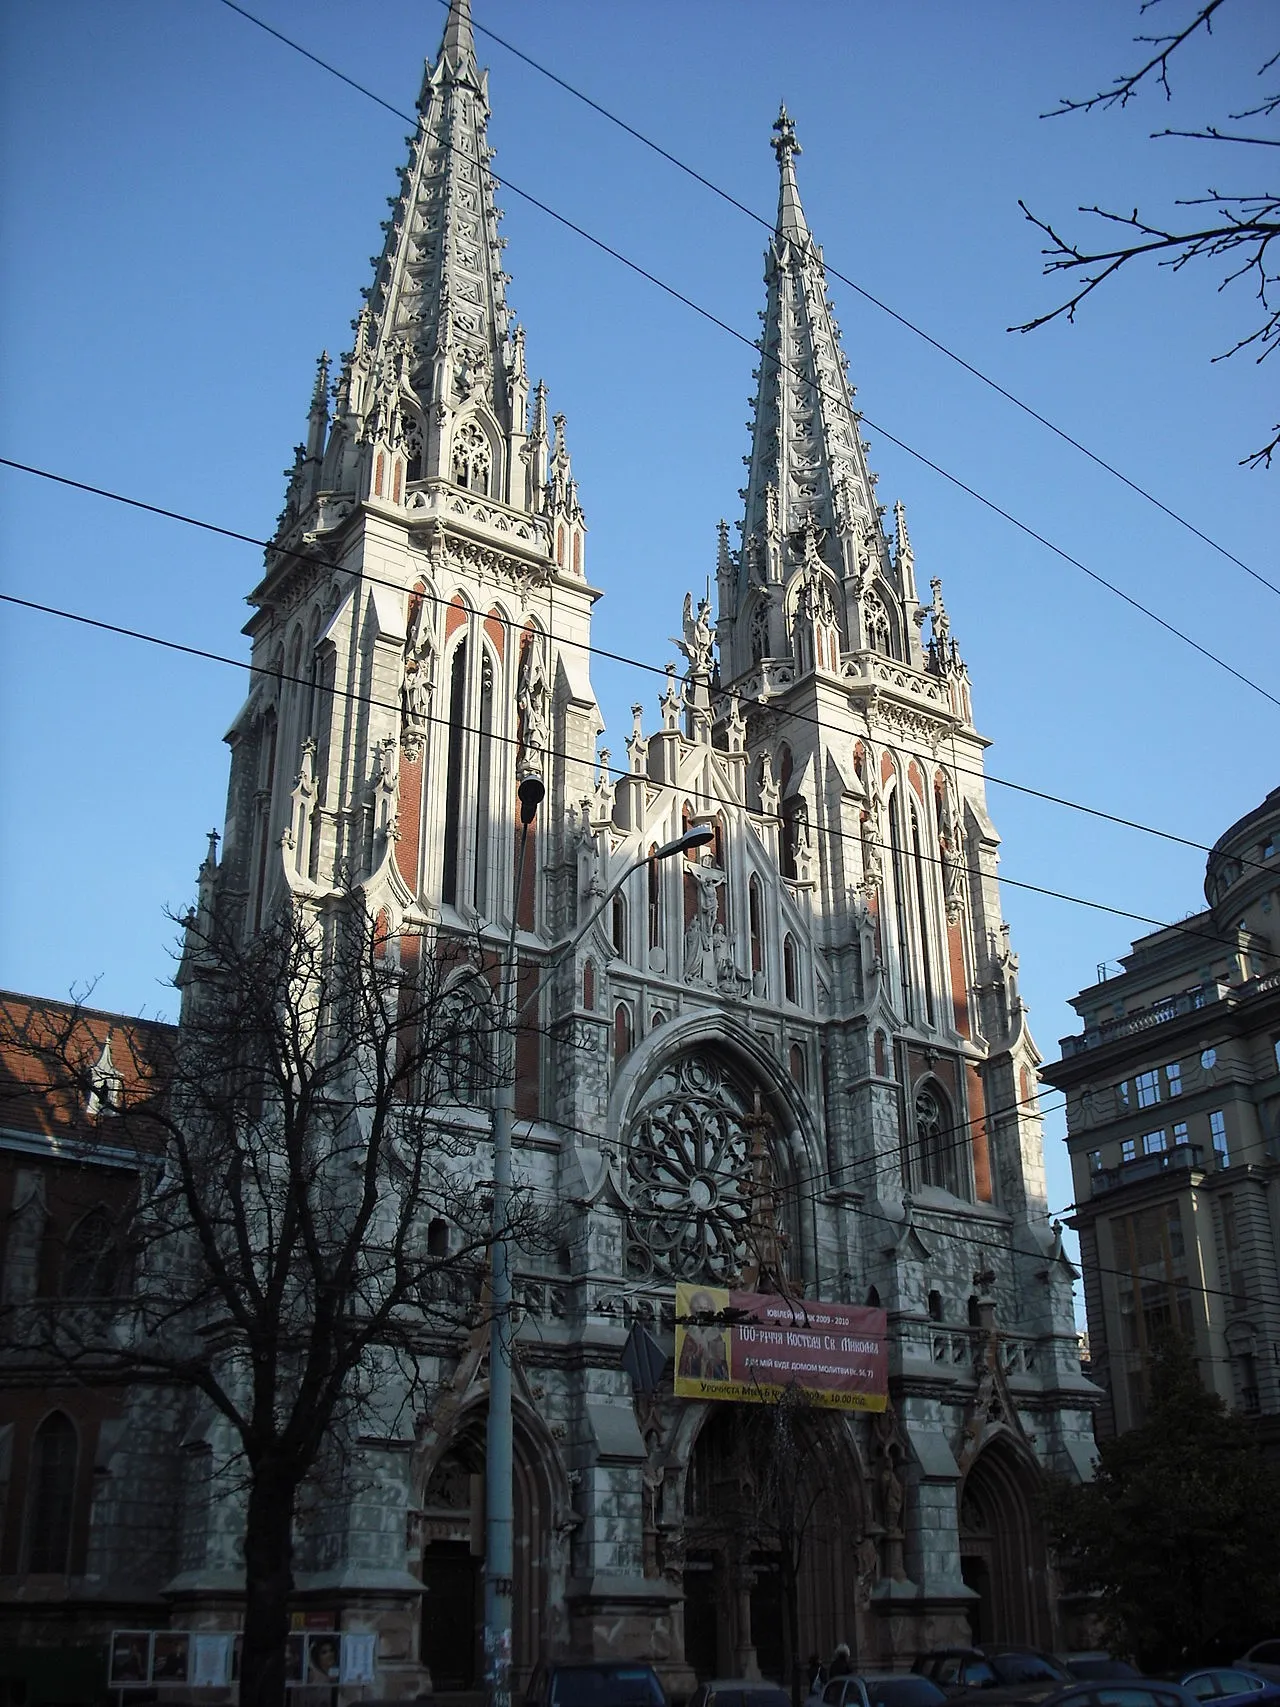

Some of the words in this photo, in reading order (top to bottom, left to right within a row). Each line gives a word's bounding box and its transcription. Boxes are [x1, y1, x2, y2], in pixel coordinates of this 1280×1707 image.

[816, 1315, 830, 1324] 2009
[835, 1317, 850, 1326] 2010
[791, 1362, 817, 1372] ДОМОМ
